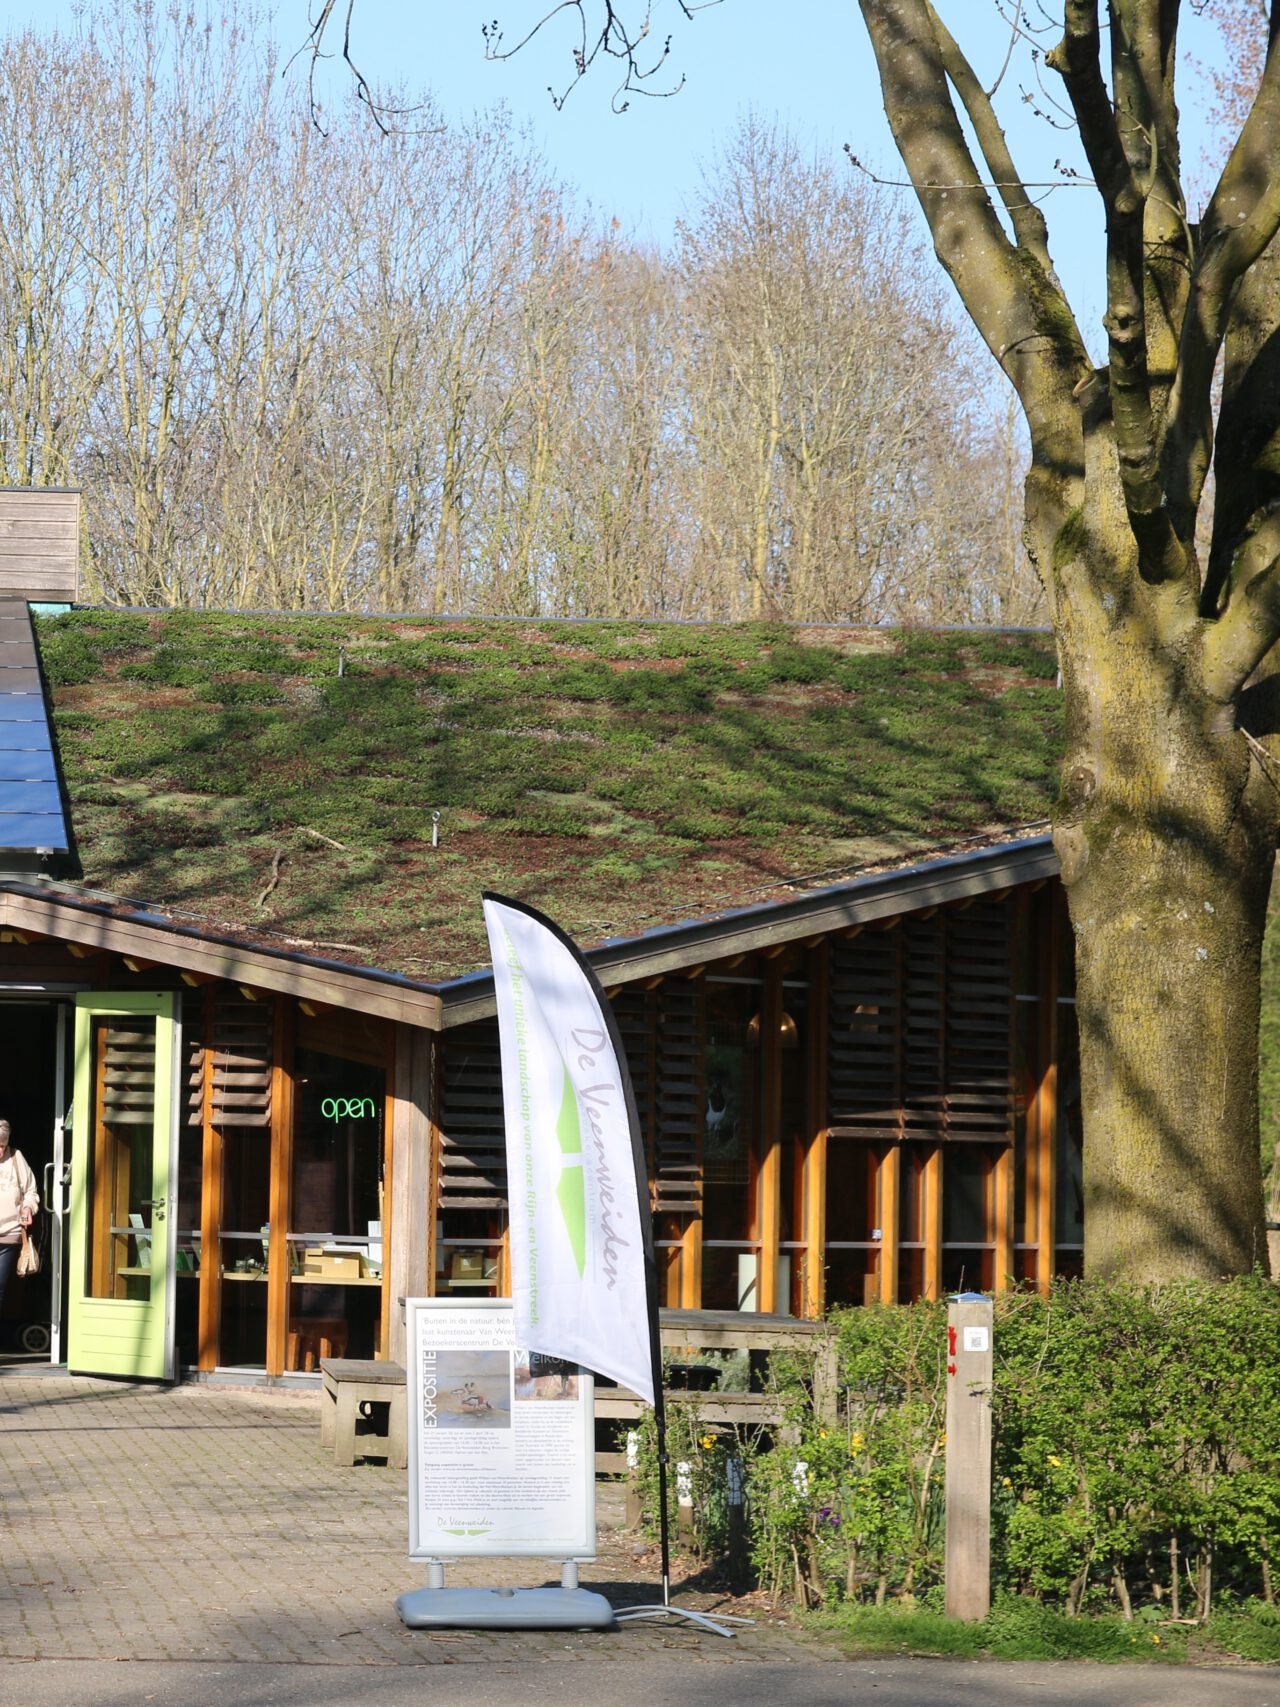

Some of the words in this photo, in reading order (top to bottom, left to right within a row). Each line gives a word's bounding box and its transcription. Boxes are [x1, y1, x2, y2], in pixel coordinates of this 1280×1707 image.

[512, 973, 525, 998] het
[514, 999, 526, 1046] unieke
[571, 1027, 607, 1072] De
[518, 1048, 532, 1121] landschap
[321, 1097, 375, 1124] open
[523, 1123, 532, 1150] van
[525, 1155, 536, 1187] onze
[580, 1083, 631, 1291] Veenweiden
[525, 1190, 536, 1223] Rijn-
[528, 1226, 536, 1243] en
[422, 1339, 490, 1347] Bezoekerscentrum
[492, 1338, 504, 1347] De
[437, 1328, 477, 1336] kunstenaar
[479, 1328, 493, 1336] Van
[423, 1351, 437, 1428] EXPOSITIE
[437, 1516, 448, 1527] De
